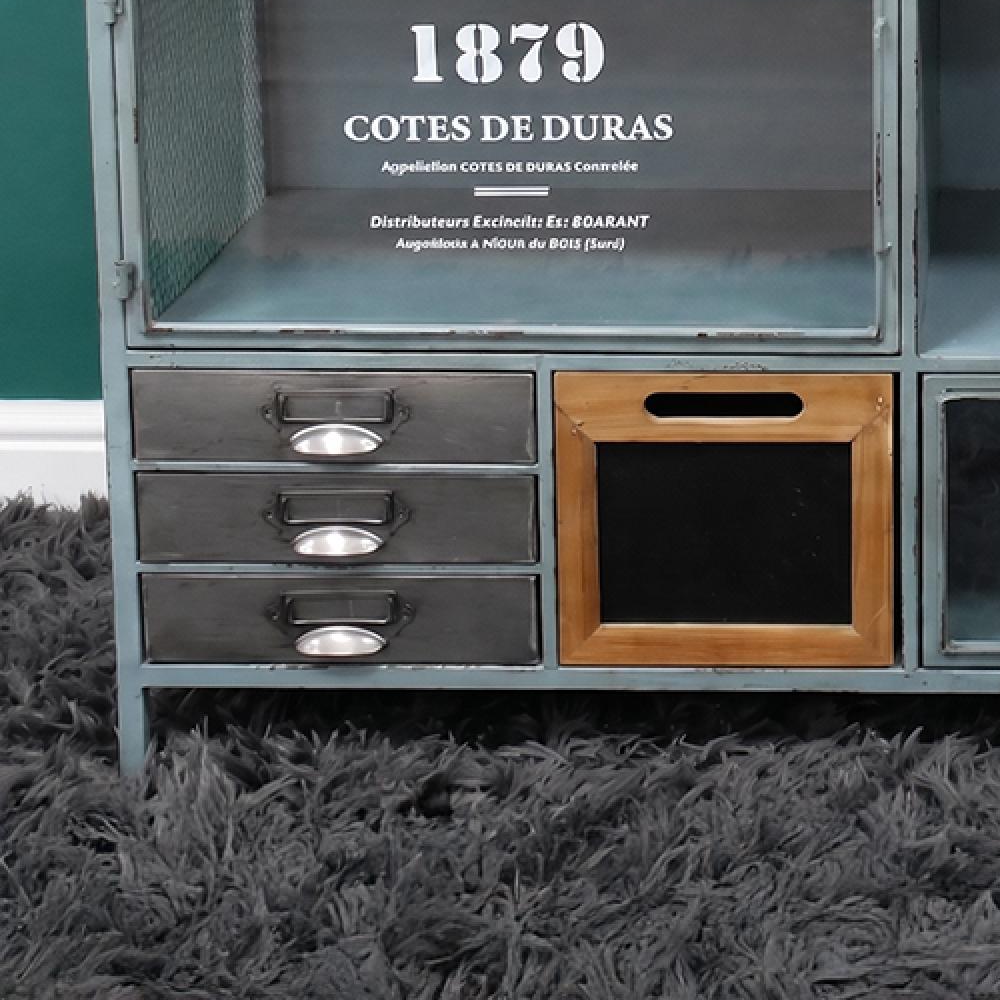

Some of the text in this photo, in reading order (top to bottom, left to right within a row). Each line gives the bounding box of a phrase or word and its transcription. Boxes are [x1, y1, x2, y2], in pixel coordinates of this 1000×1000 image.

[409, 21, 605, 85] 1879
[343, 113, 673, 143] COTES DE DURAS
[459, 161, 503, 174] COTES
[505, 161, 523, 174] DE
[525, 161, 571, 174] DURAS
[369, 214, 469, 229] Distributeurs
